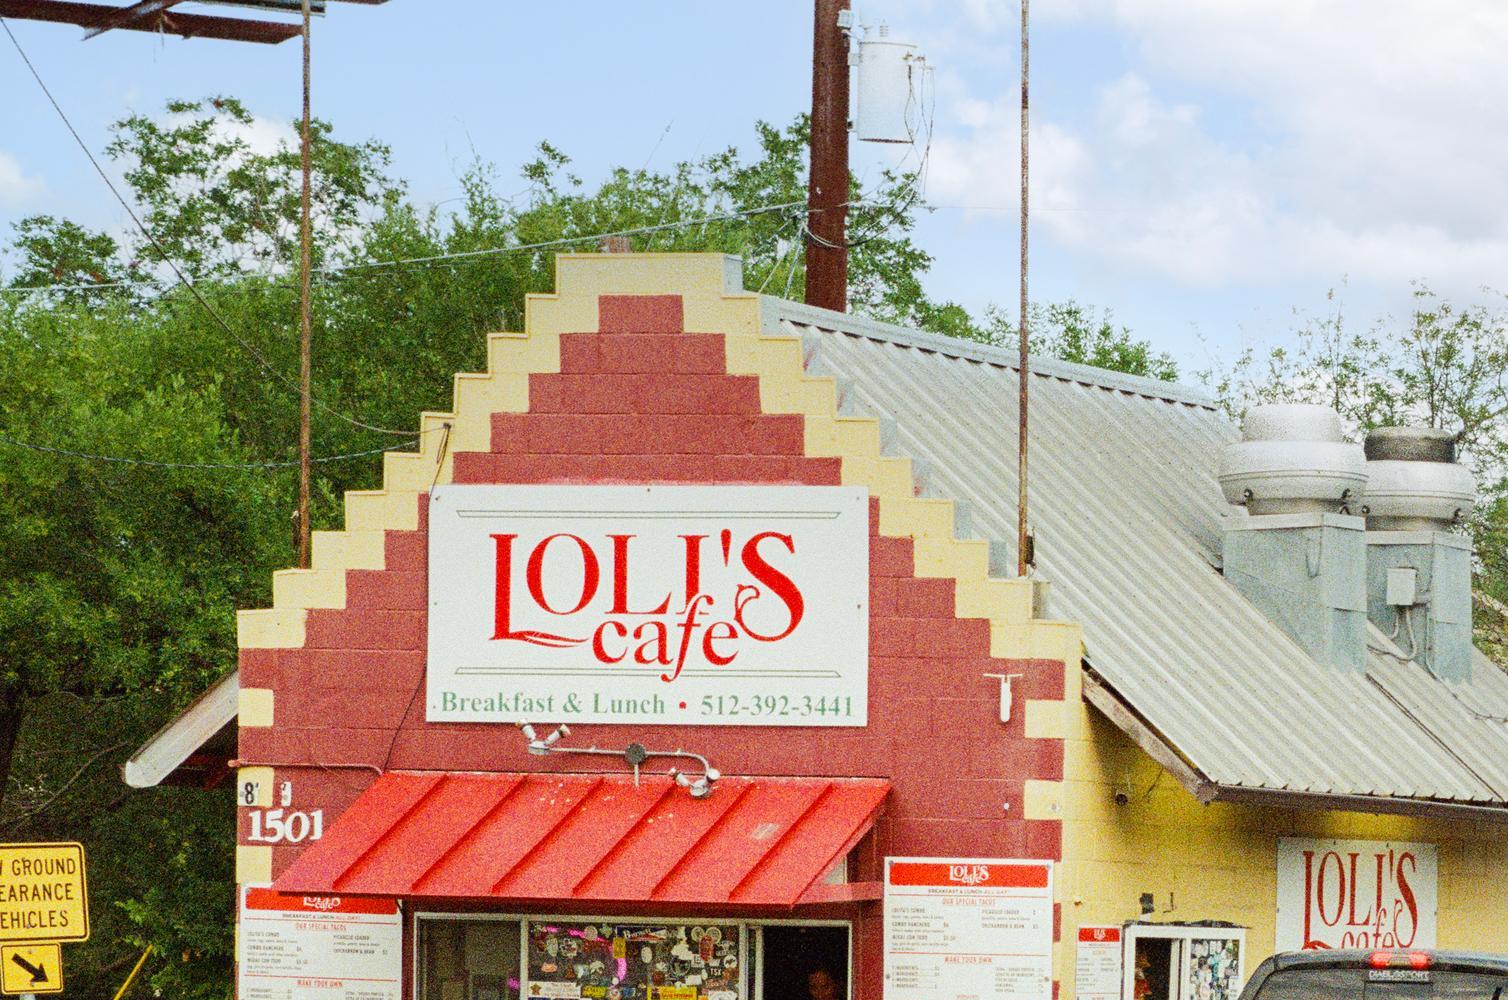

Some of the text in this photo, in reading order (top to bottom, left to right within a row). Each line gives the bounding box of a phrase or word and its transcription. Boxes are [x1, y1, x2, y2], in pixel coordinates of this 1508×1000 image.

[488, 529, 805, 649] LOLI'S
[592, 594, 740, 682] cafe
[441, 691, 855, 718] Breakfast & Lunch 512-392-3441
[247, 808, 323, 843] 1501
[12, 858, 76, 876] GROUND
[949, 865, 989, 881] LOLI'S
[1302, 848, 1418, 950] LOLI'S
